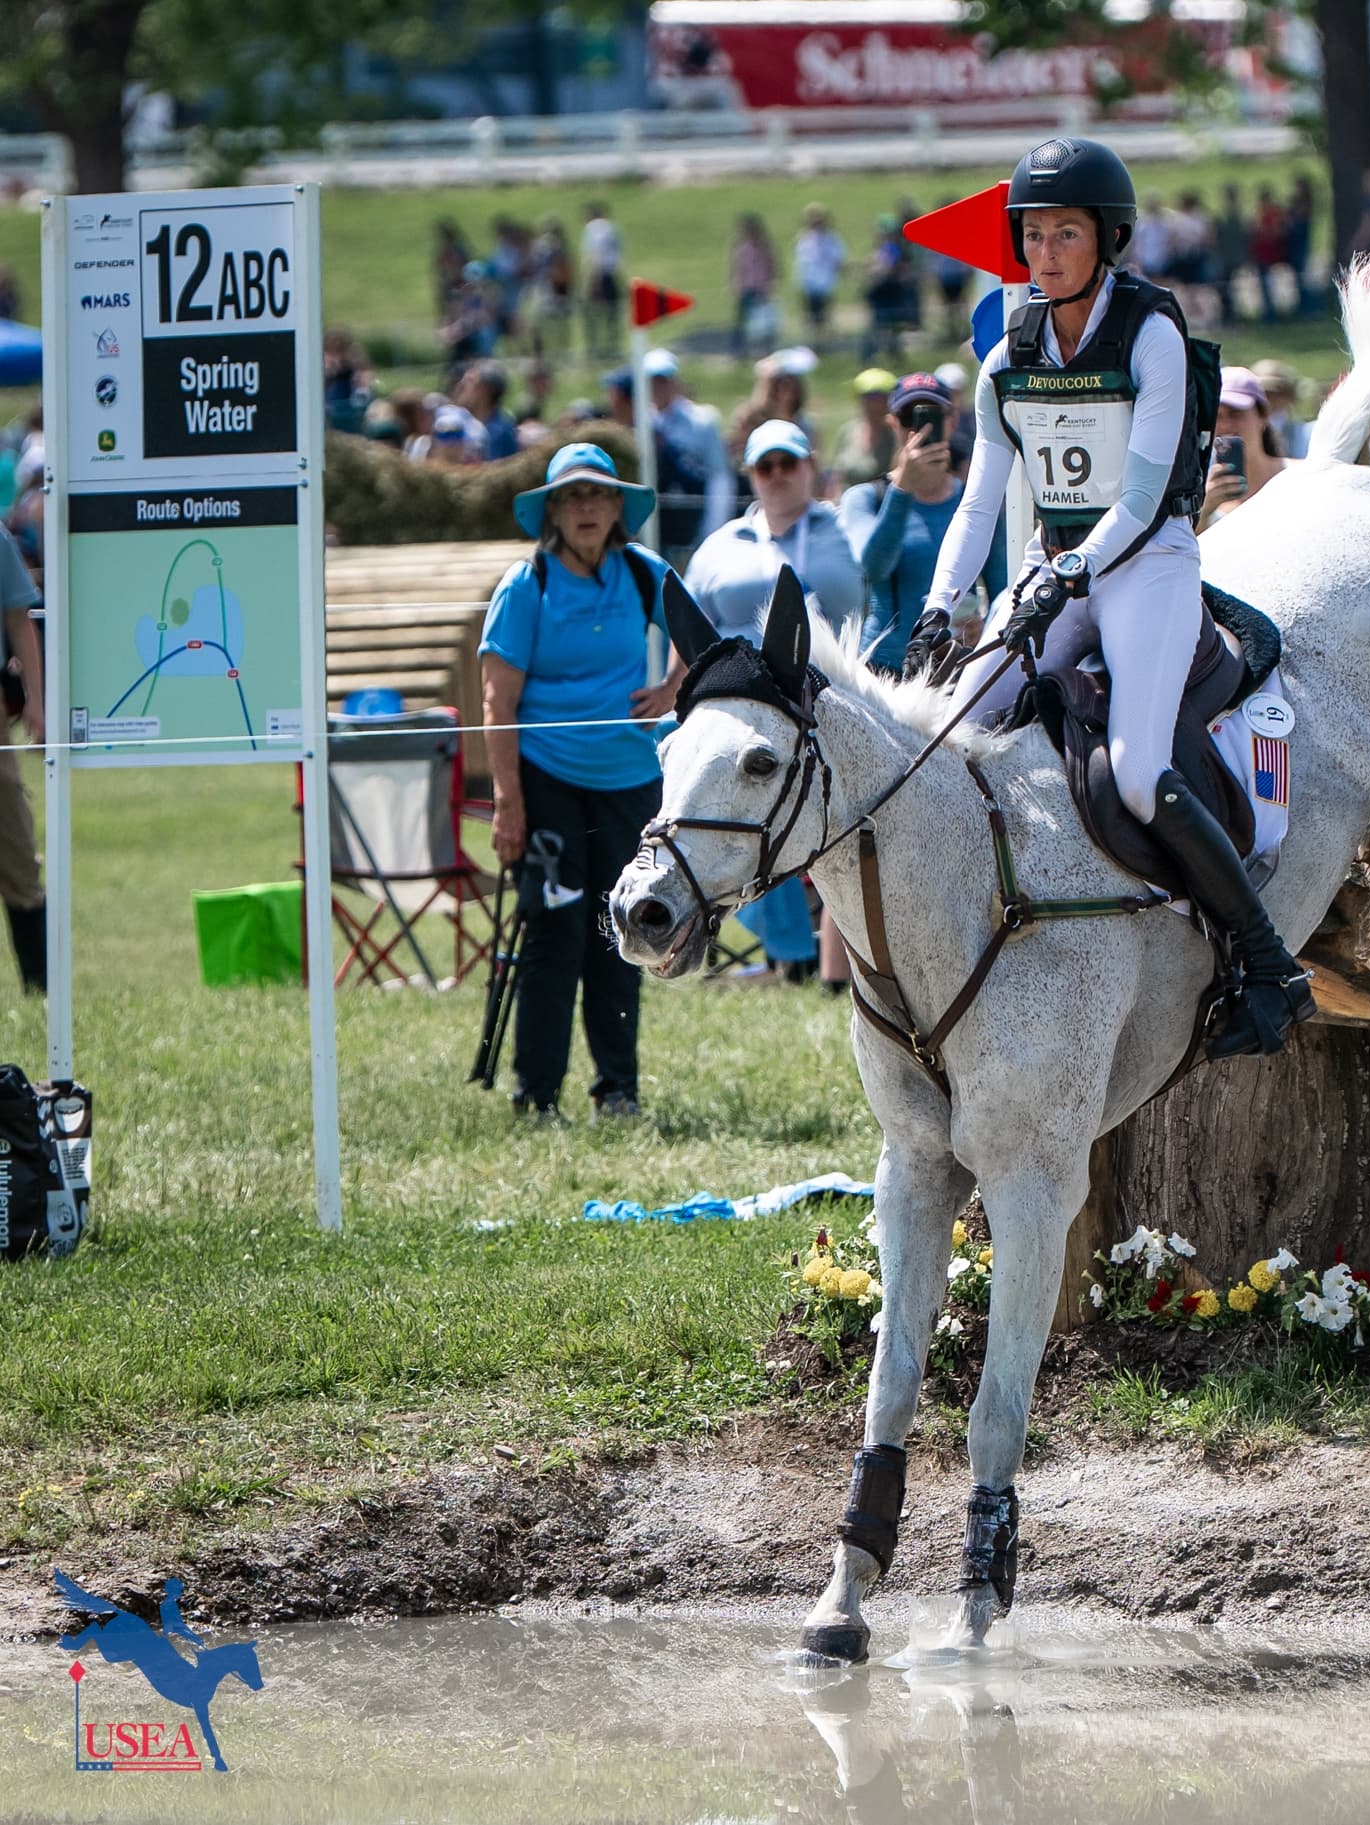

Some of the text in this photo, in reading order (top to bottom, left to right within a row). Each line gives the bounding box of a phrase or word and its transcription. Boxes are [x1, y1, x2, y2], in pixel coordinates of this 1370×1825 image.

[74, 259, 135, 270] DEFENDER
[94, 292, 130, 308] MARS
[180, 355, 260, 397] Spring
[1027, 375, 1102, 389] DEVOUCOUX
[185, 399, 257, 434] Water
[1037, 446, 1091, 487] 19
[1043, 491, 1088, 503] HAMEL
[136, 496, 241, 523] Route Options
[1266, 706, 1285, 722] 19
[0, 1160, 12, 1248] lululemon
